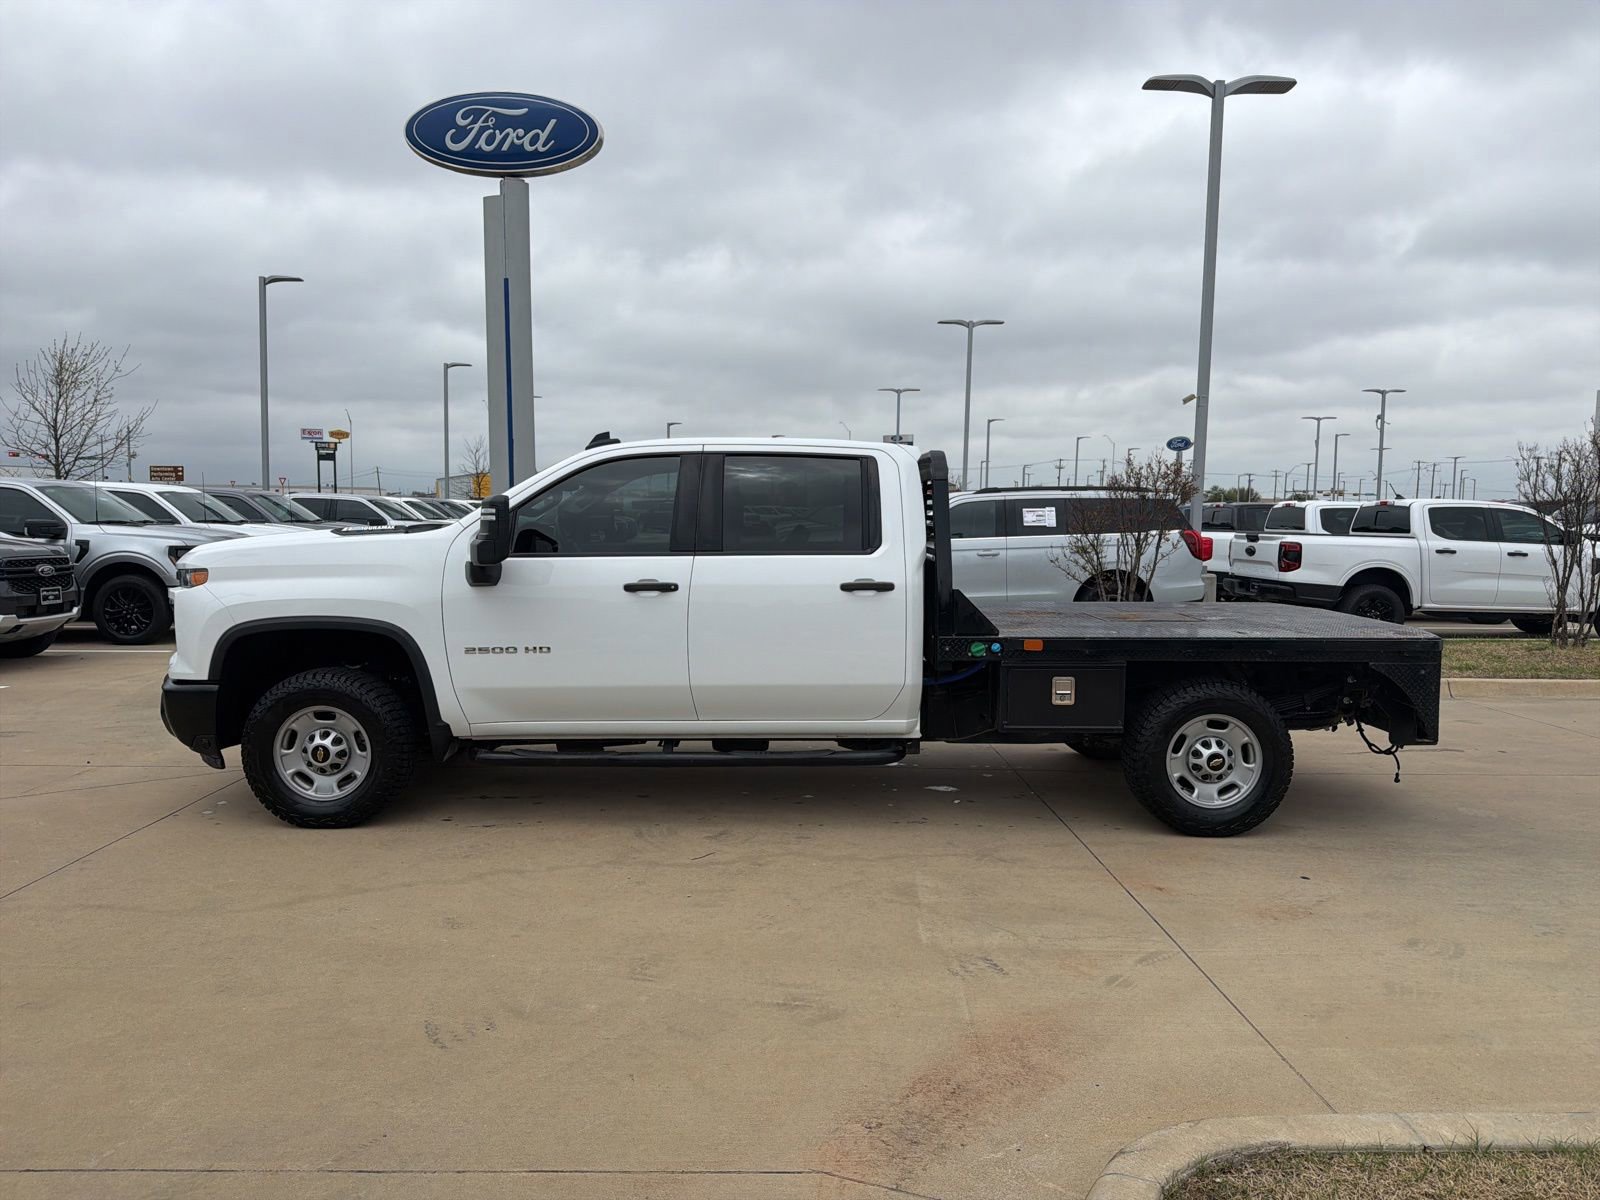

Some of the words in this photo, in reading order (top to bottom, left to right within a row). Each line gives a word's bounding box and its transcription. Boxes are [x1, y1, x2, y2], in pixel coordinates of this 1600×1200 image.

[445, 105, 557, 152] Ford
[464, 646, 518, 655] 2500
[524, 646, 551, 654] HD
